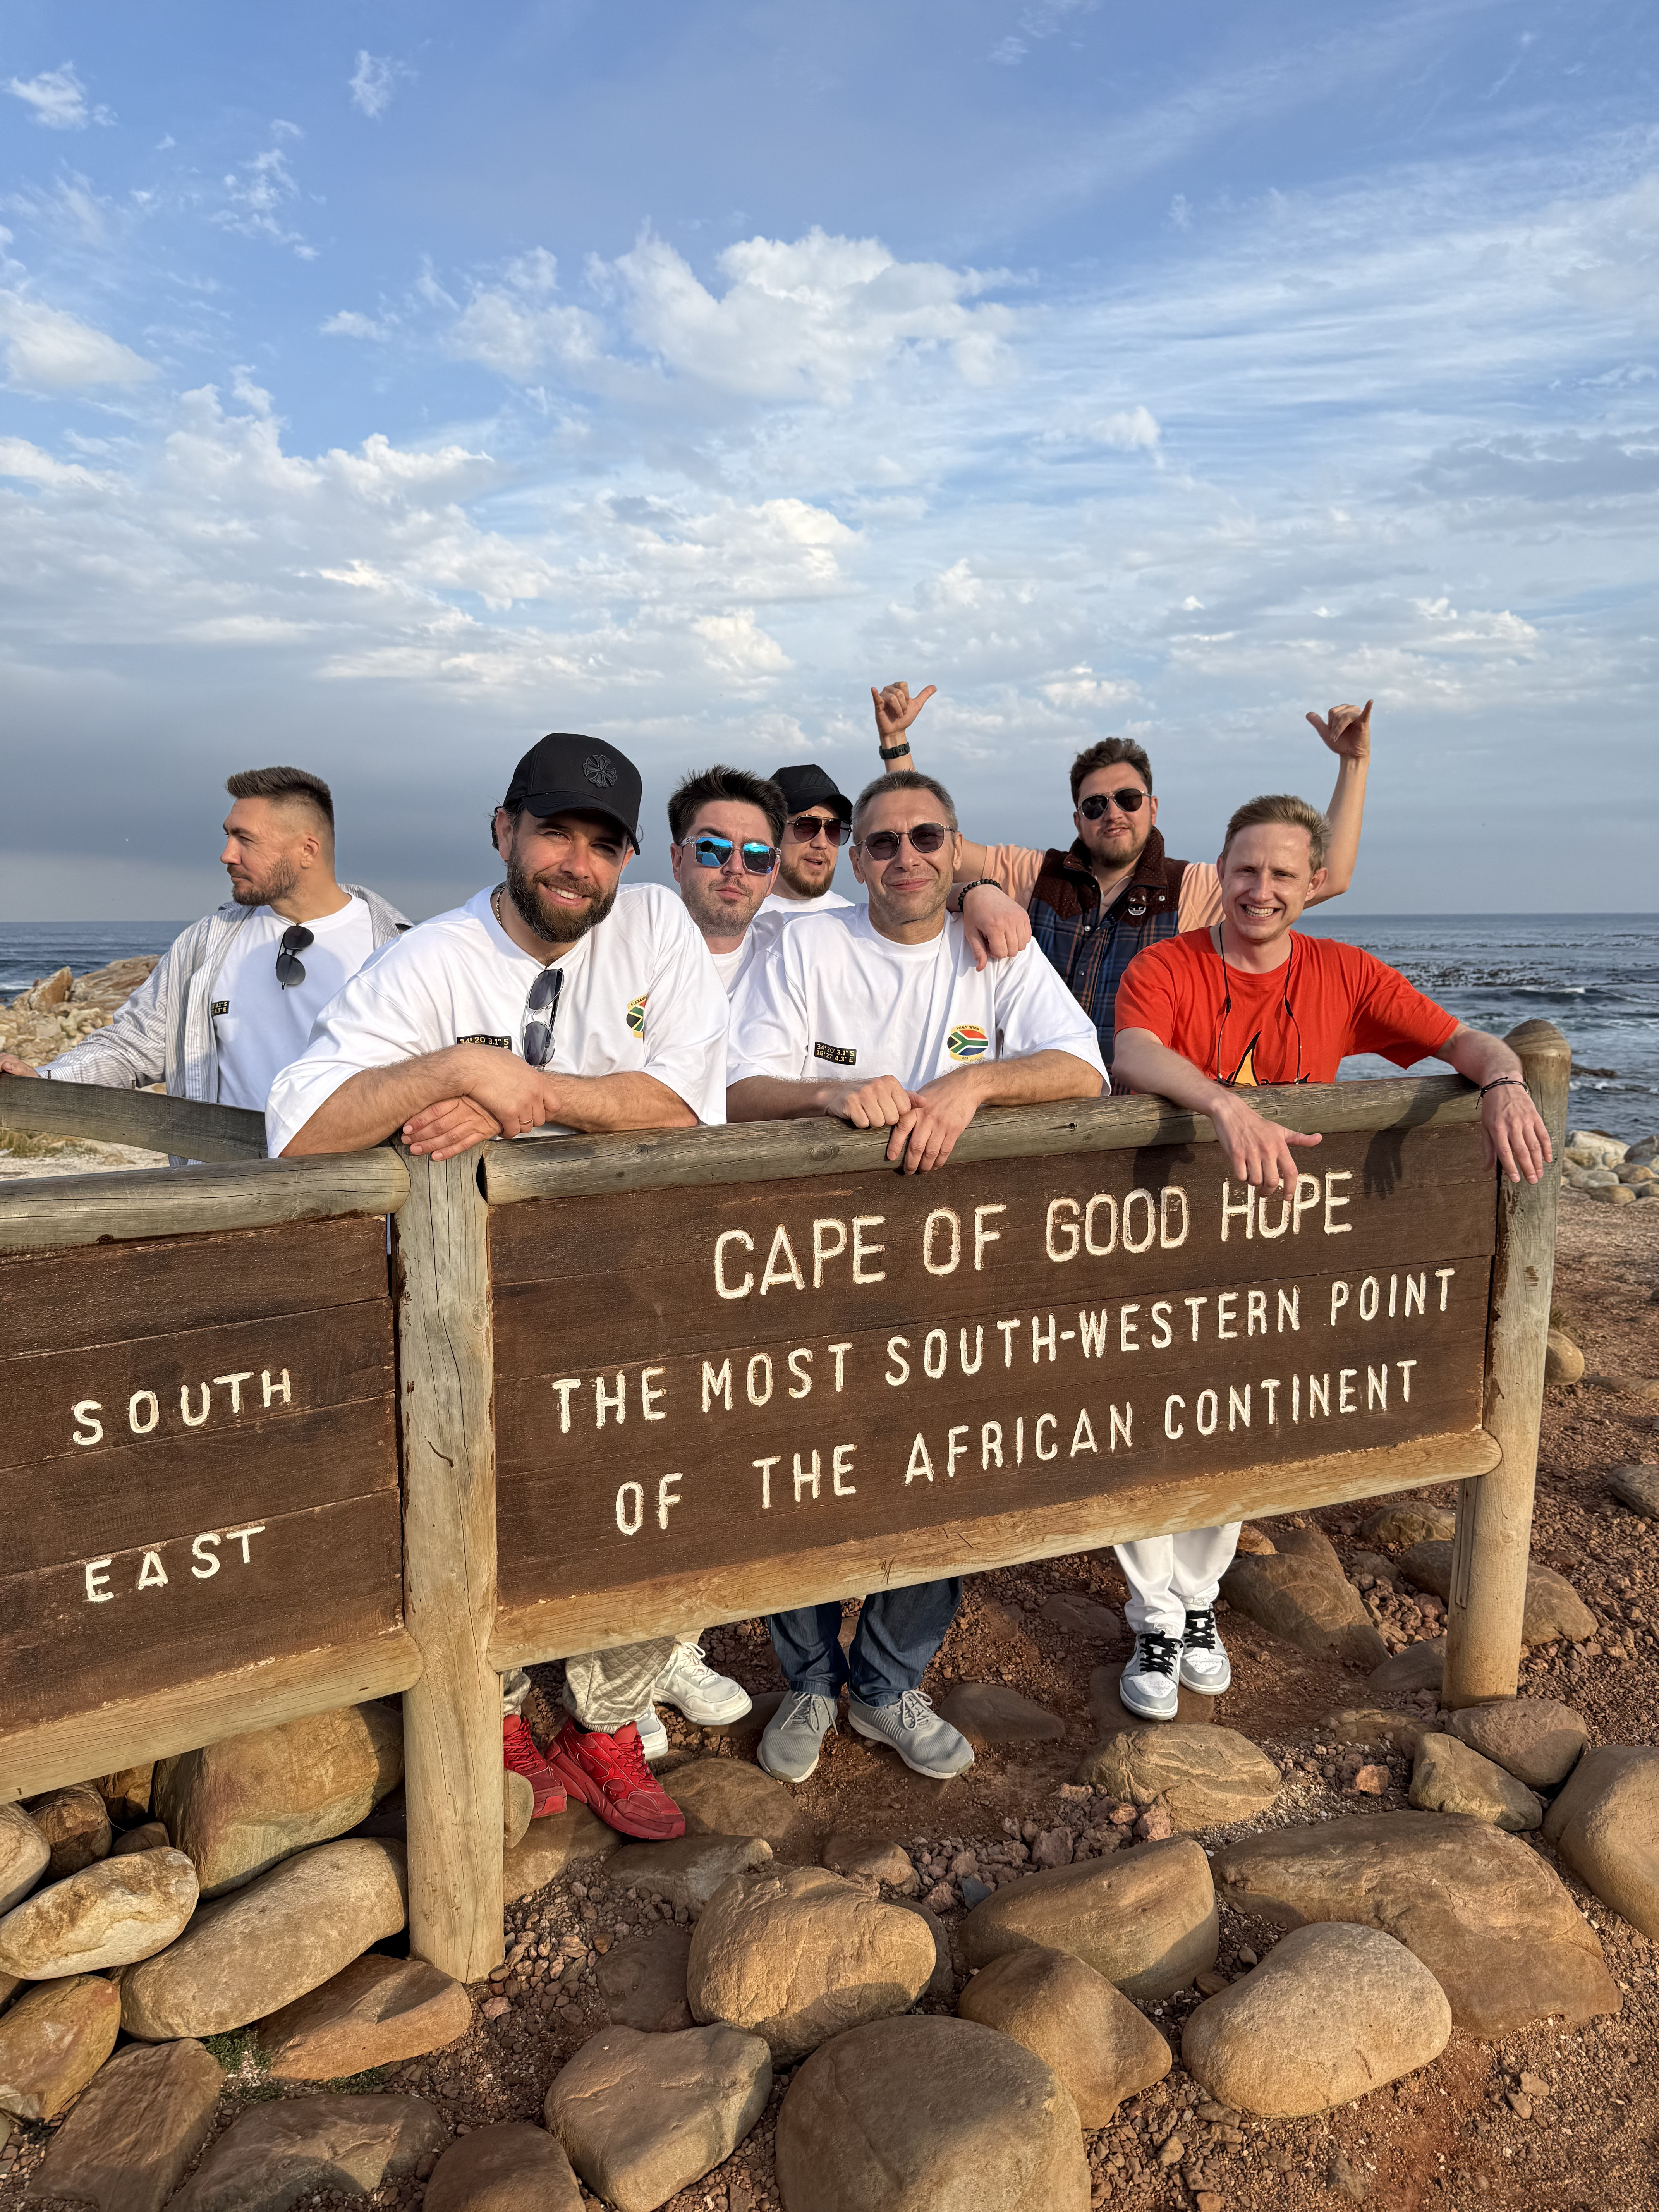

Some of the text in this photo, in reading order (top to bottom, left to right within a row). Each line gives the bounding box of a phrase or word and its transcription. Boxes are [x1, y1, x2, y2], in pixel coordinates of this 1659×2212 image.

[714, 1216, 885, 1299] CAPE
[923, 1204, 1006, 1276] OF
[1045, 1187, 1188, 1262] GOOD
[72, 1368, 292, 1445] SOUTH
[551, 1268, 1455, 1434] THE MOST SOUTH-WESTERN POINT
[615, 1360, 1417, 1536] OF THE AFRICAN CONTINENT
[85, 1526, 266, 1603] EAST
